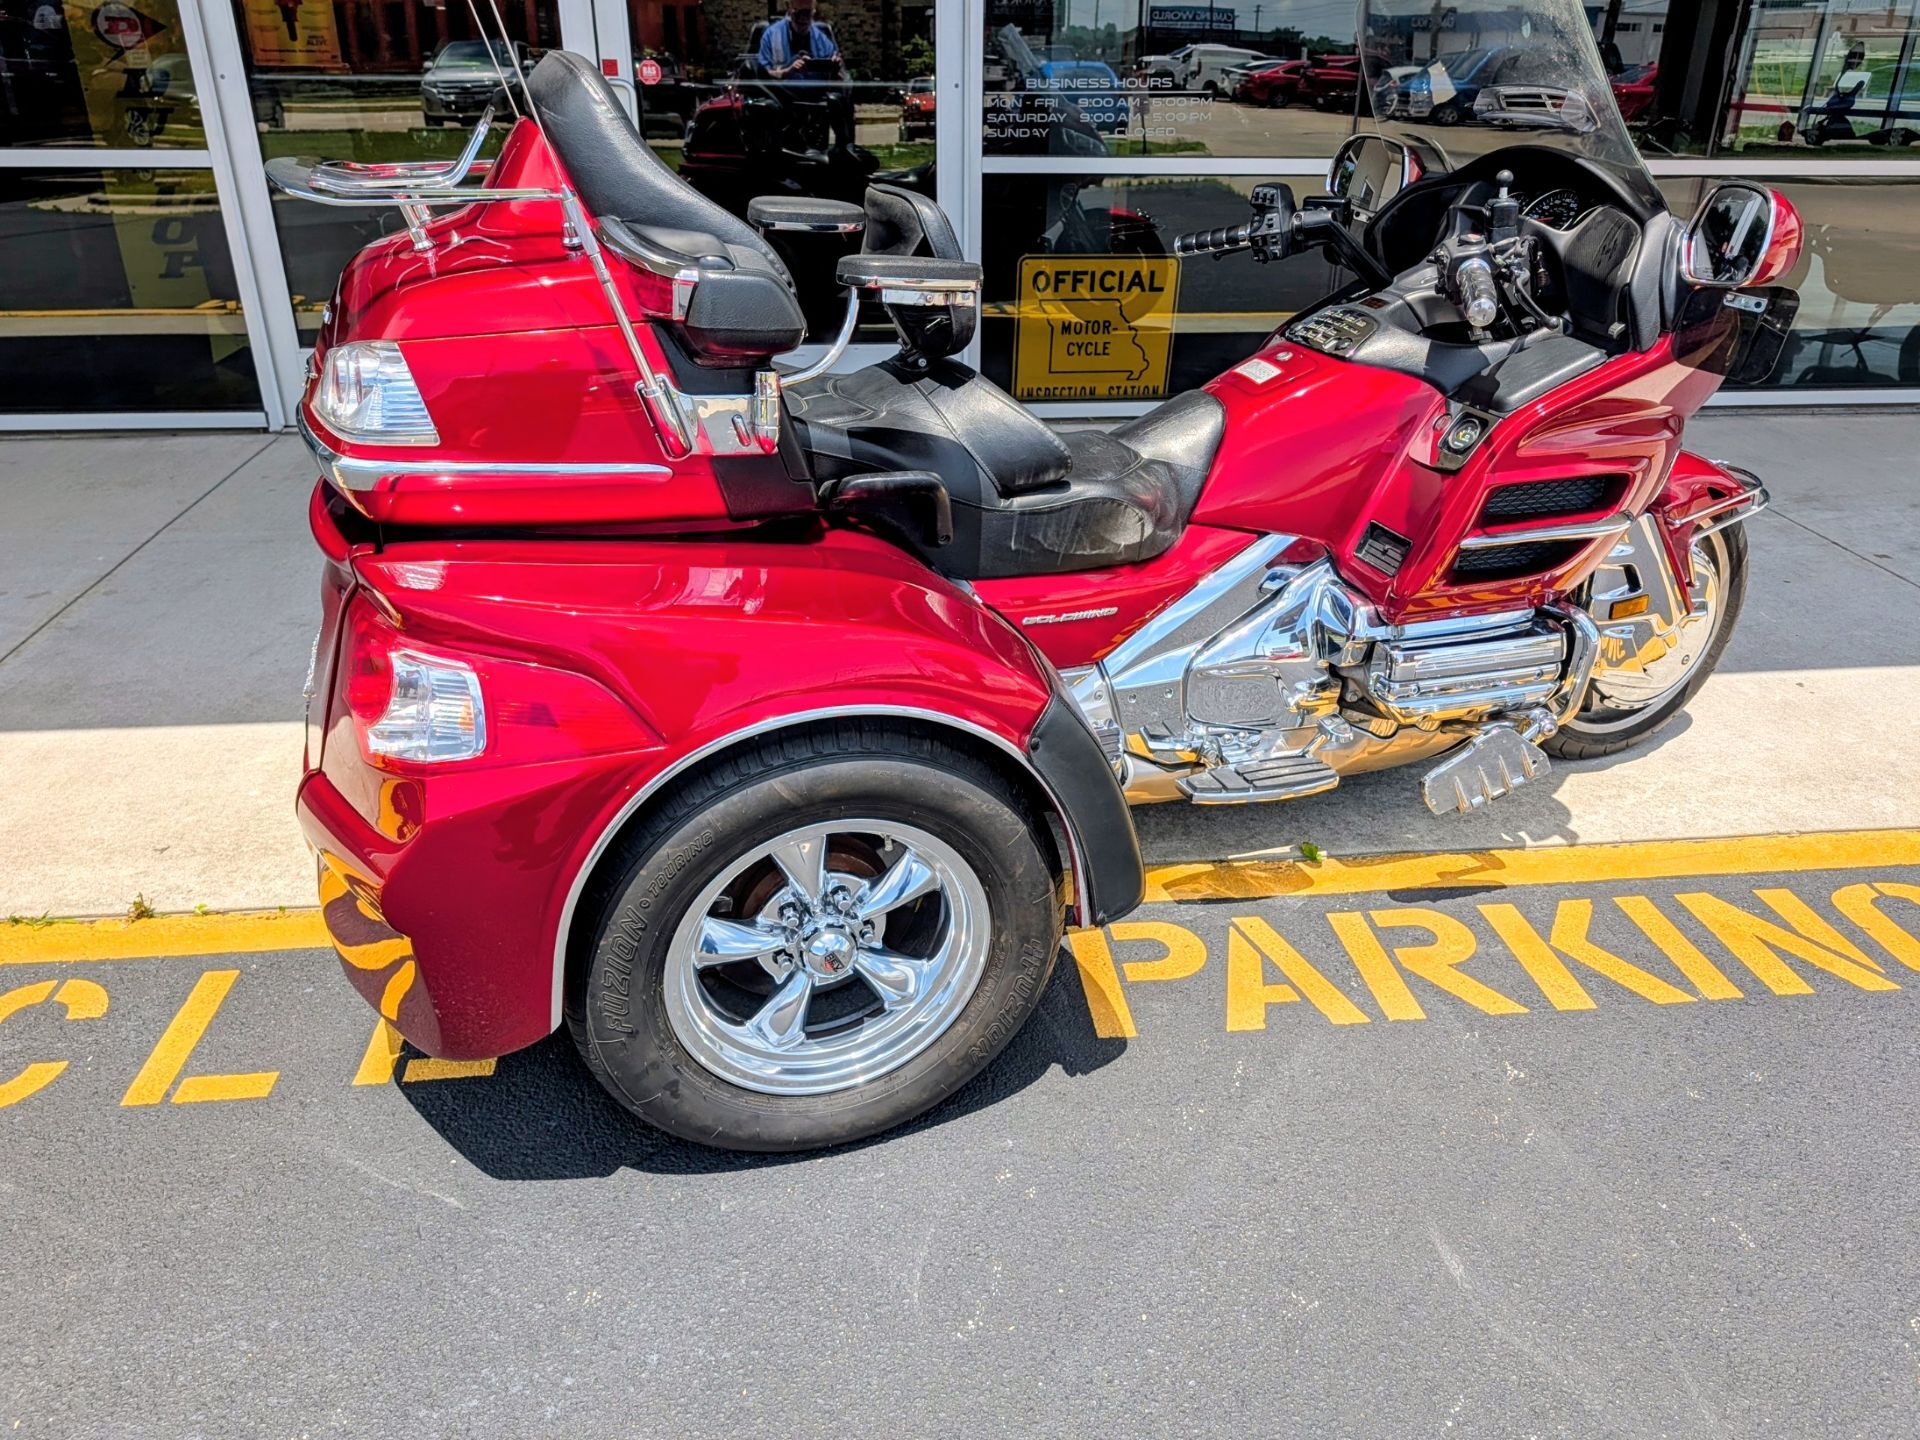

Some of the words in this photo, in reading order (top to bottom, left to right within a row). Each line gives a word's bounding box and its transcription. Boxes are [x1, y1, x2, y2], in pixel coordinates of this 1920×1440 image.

[1025, 77, 1111, 89] BUSINESS
[1114, 77, 1173, 89] HOURS
[986, 98, 1023, 108] MON
[1034, 98, 1059, 108] FRI
[1077, 97, 1113, 108] 9:00
[1116, 97, 1141, 108] AM
[1190, 96, 1213, 107] PM
[986, 113, 1068, 123] SATURDAY
[1079, 113, 1115, 123] 9:00
[1117, 113, 1141, 123] AM
[1152, 112, 1188, 122] 5:00
[1190, 112, 1213, 122] PM
[986, 127, 1050, 138] SUNDAY
[1114, 127, 1176, 137] CLOSED
[1032, 270, 1165, 293] OFFICIAL
[1060, 320, 1119, 336] MOTOR-
[1066, 341, 1112, 357] CYCLE
[1020, 386, 1097, 398] INSPECTION
[1107, 385, 1161, 398] STATION
[601, 905, 649, 1034] FUZION
[648, 831, 714, 898] TOURING
[968, 956, 1041, 1066] FUZION
